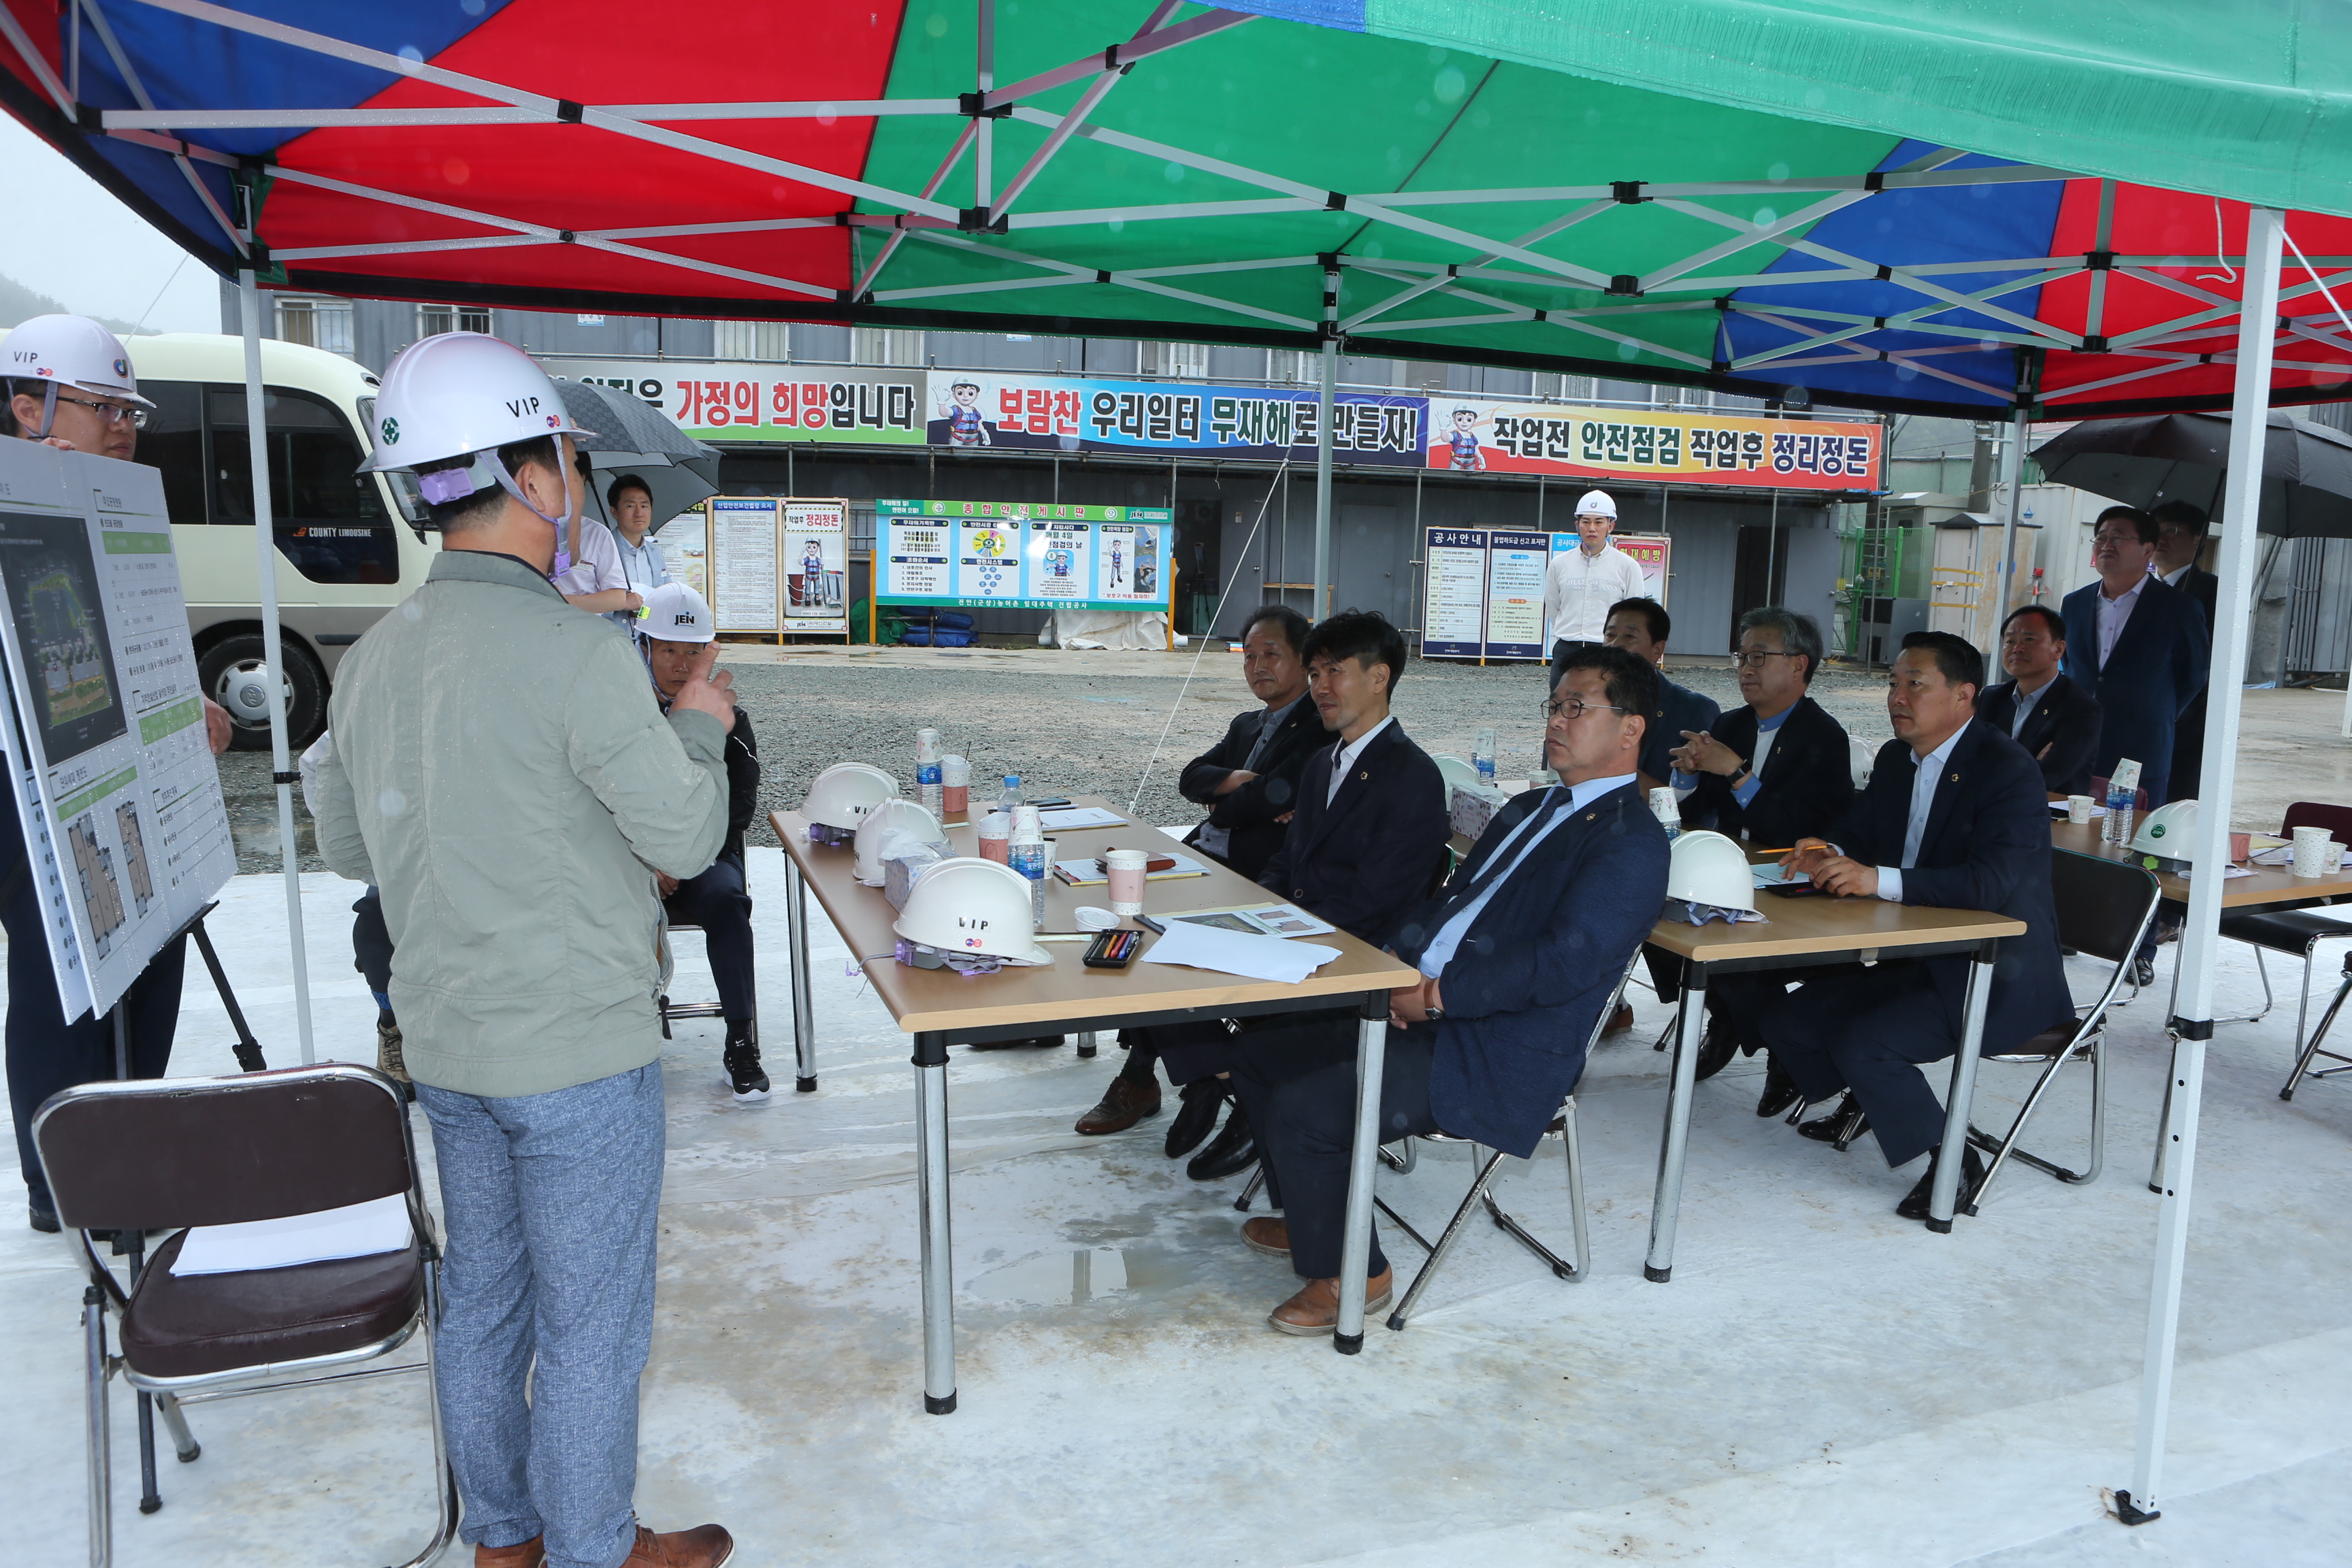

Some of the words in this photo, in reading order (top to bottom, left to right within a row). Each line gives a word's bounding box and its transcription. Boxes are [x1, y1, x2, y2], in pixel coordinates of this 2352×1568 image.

[14, 351, 38, 363] VIP
[506, 397, 540, 418] VIP
[676, 380, 760, 427] 가정의
[772, 382, 915, 431] 희망입니다
[998, 388, 1081, 436] 보람찬
[1092, 393, 1200, 441] 우리일터
[1211, 398, 1319, 446] 무재해로
[1333, 403, 1417, 452] 만들자!
[1493, 417, 1571, 459] 작업전
[1581, 422, 1680, 466] 안전점검
[1690, 429, 1764, 470] 작업후
[1771, 434, 1869, 475] 정리정돈
[789, 515, 804, 524] 작업후
[806, 514, 839, 527] 정리정돈
[308, 527, 337, 538] COUNTY
[338, 528, 372, 538] LIMOUSINE
[1433, 532, 1482, 546] 공사안내
[1493, 536, 1519, 544] 불법하도급
[1530, 537, 1546, 546] 표지판
[1024, 600, 1054, 608] 임대주택
[855, 806, 868, 815] VI
[958, 917, 989, 930] VIP
